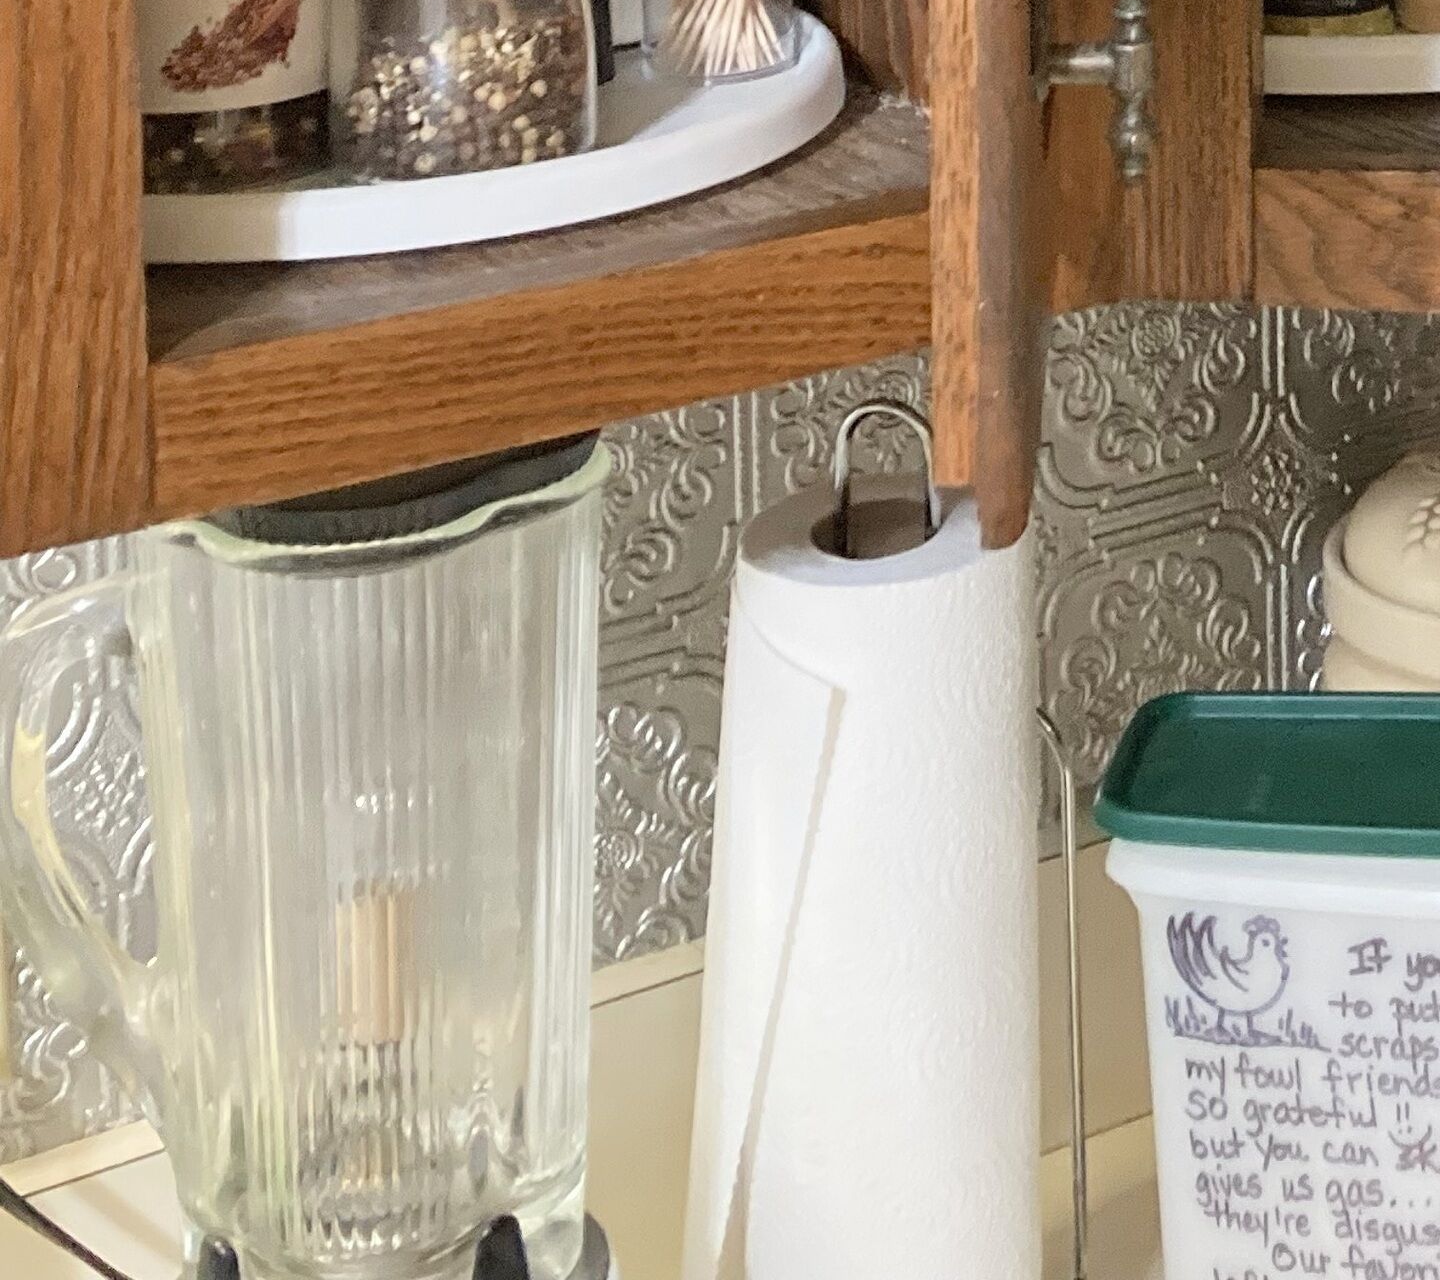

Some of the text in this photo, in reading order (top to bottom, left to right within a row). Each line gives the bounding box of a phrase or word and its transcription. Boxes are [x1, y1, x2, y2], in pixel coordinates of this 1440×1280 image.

[1347, 937, 1393, 976] If
[1328, 991, 1373, 1018] to
[1184, 1056, 1226, 1097] my
[1234, 1050, 1302, 1091] fowl
[1338, 1032, 1440, 1075] scraps
[1242, 1091, 1377, 1137] grateful
[1189, 1126, 1246, 1160] but
[1322, 1140, 1379, 1167] can
[1195, 1163, 1263, 1208] gives
[1281, 1172, 1314, 1202] us
[1203, 1198, 1312, 1248] they're
[1271, 1242, 1332, 1274] Our
